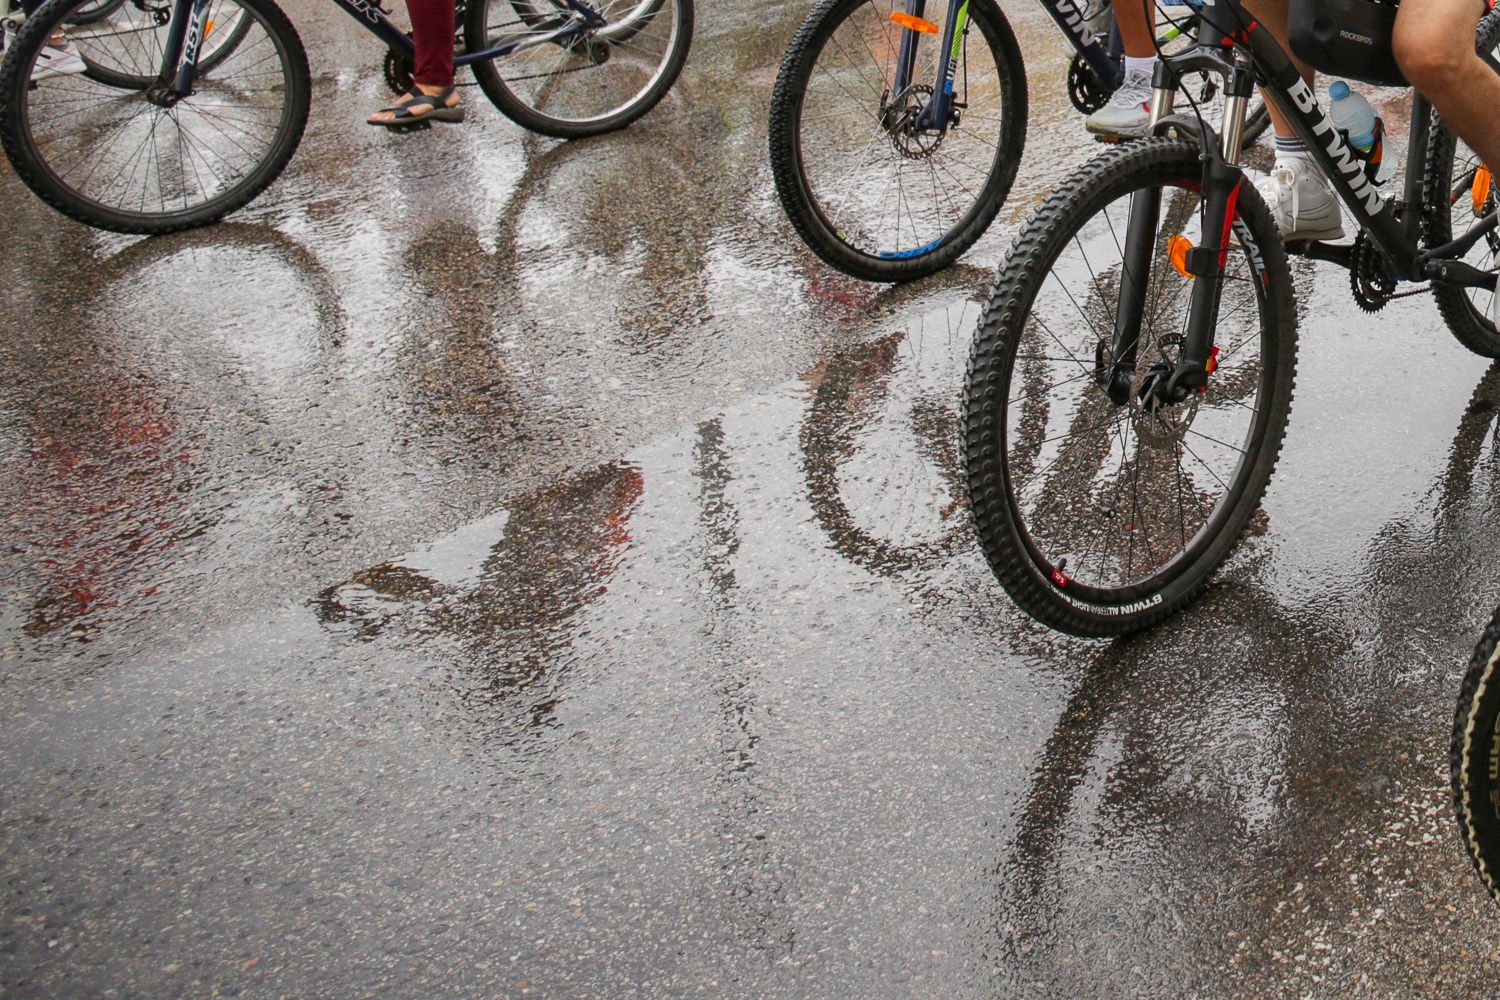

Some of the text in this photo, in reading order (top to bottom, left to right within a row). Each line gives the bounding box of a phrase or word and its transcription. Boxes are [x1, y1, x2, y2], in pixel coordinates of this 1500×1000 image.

[184, 12, 199, 62] RST
[1340, 29, 1374, 46] ROCKBROS
[1232, 216, 1266, 276] TRAIL
